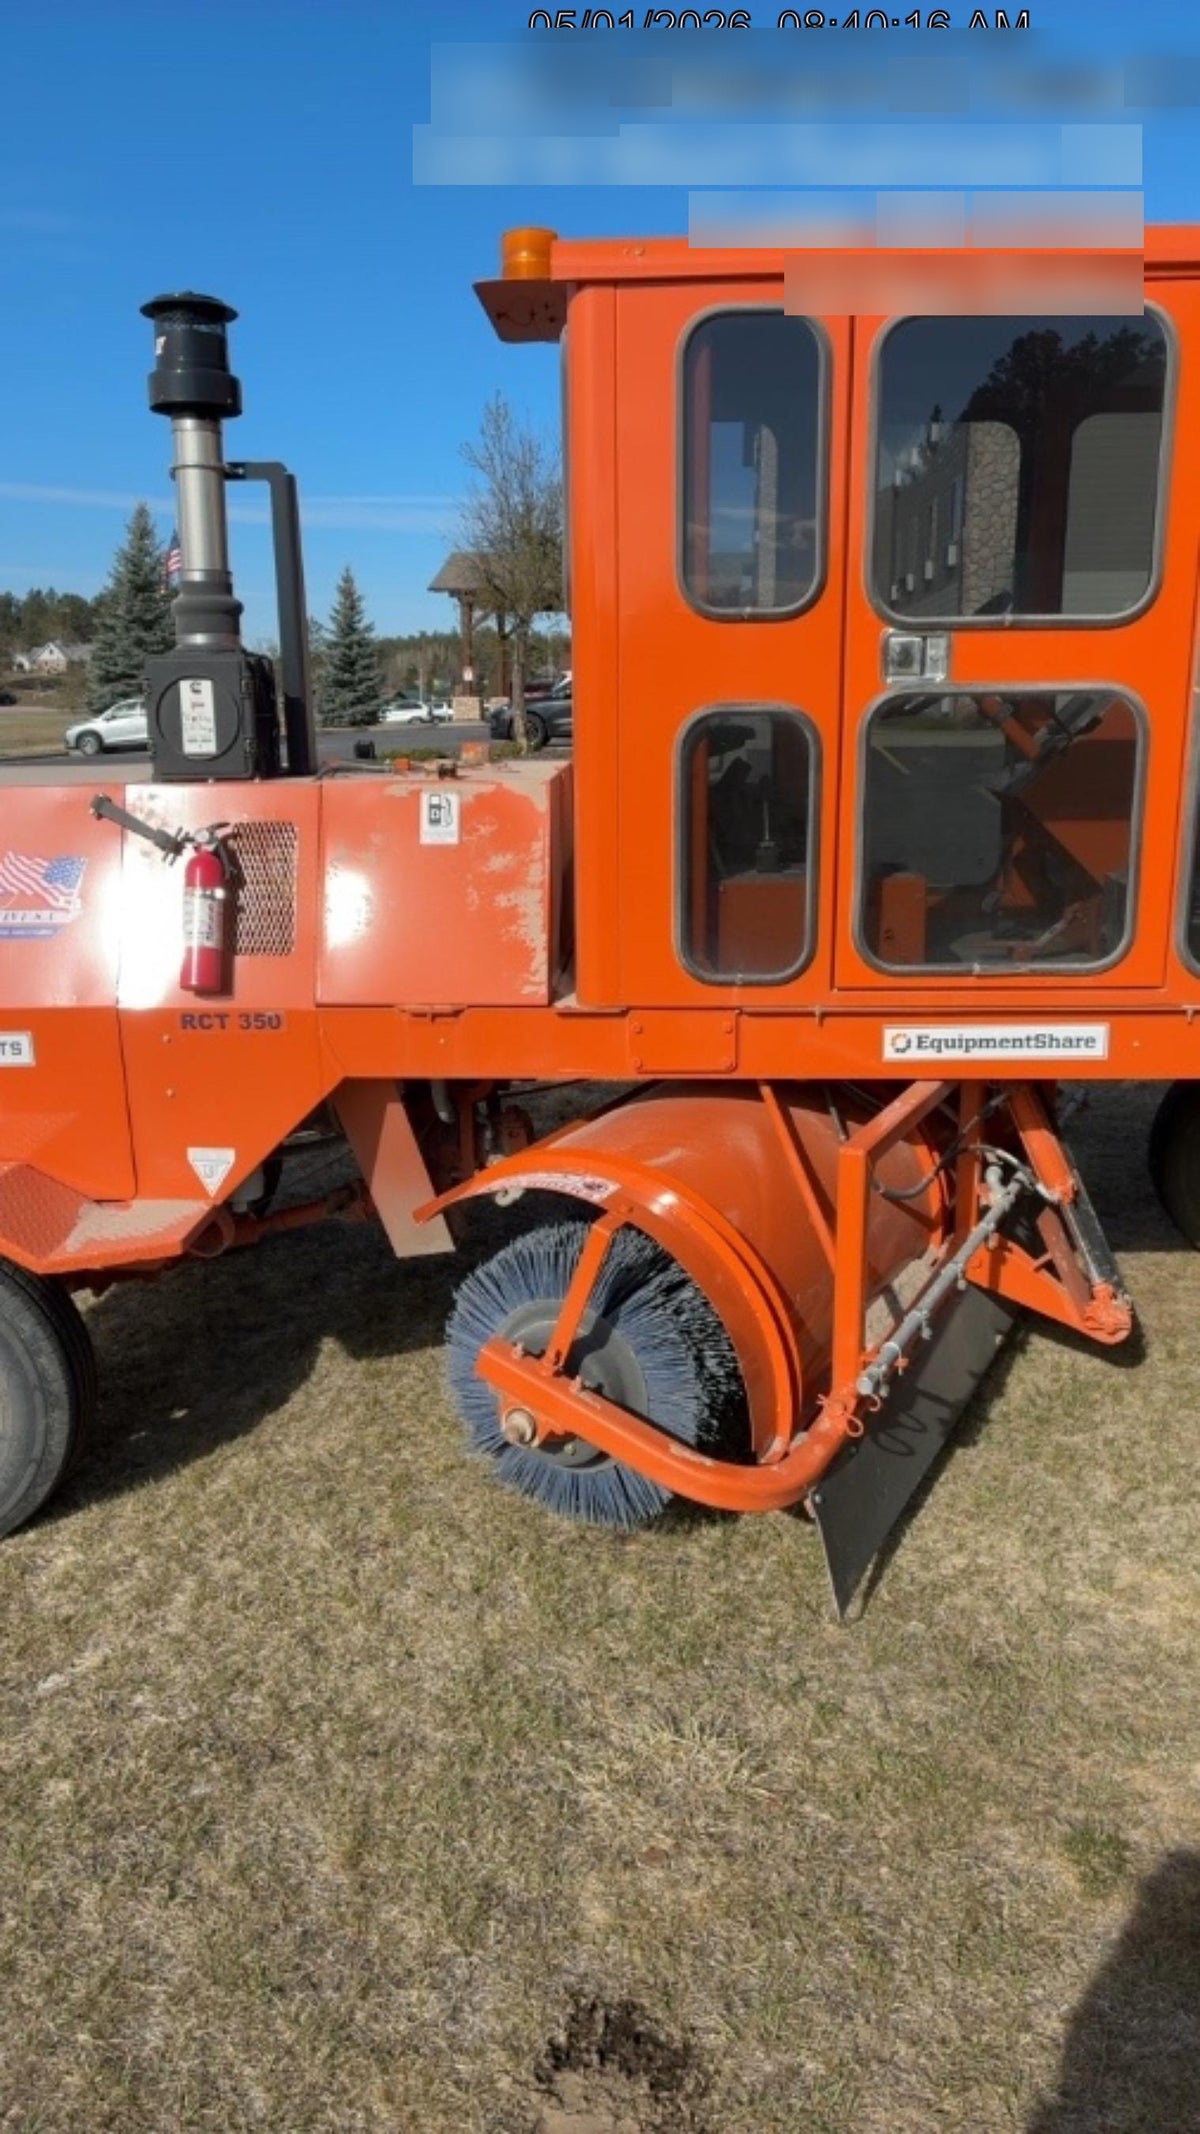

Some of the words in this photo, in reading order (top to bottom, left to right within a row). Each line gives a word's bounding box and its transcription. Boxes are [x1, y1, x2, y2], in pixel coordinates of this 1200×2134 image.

[181, 1012, 229, 1030] RCT
[239, 1012, 282, 1030] 350
[916, 1033, 1097, 1053] EquipmentShare
